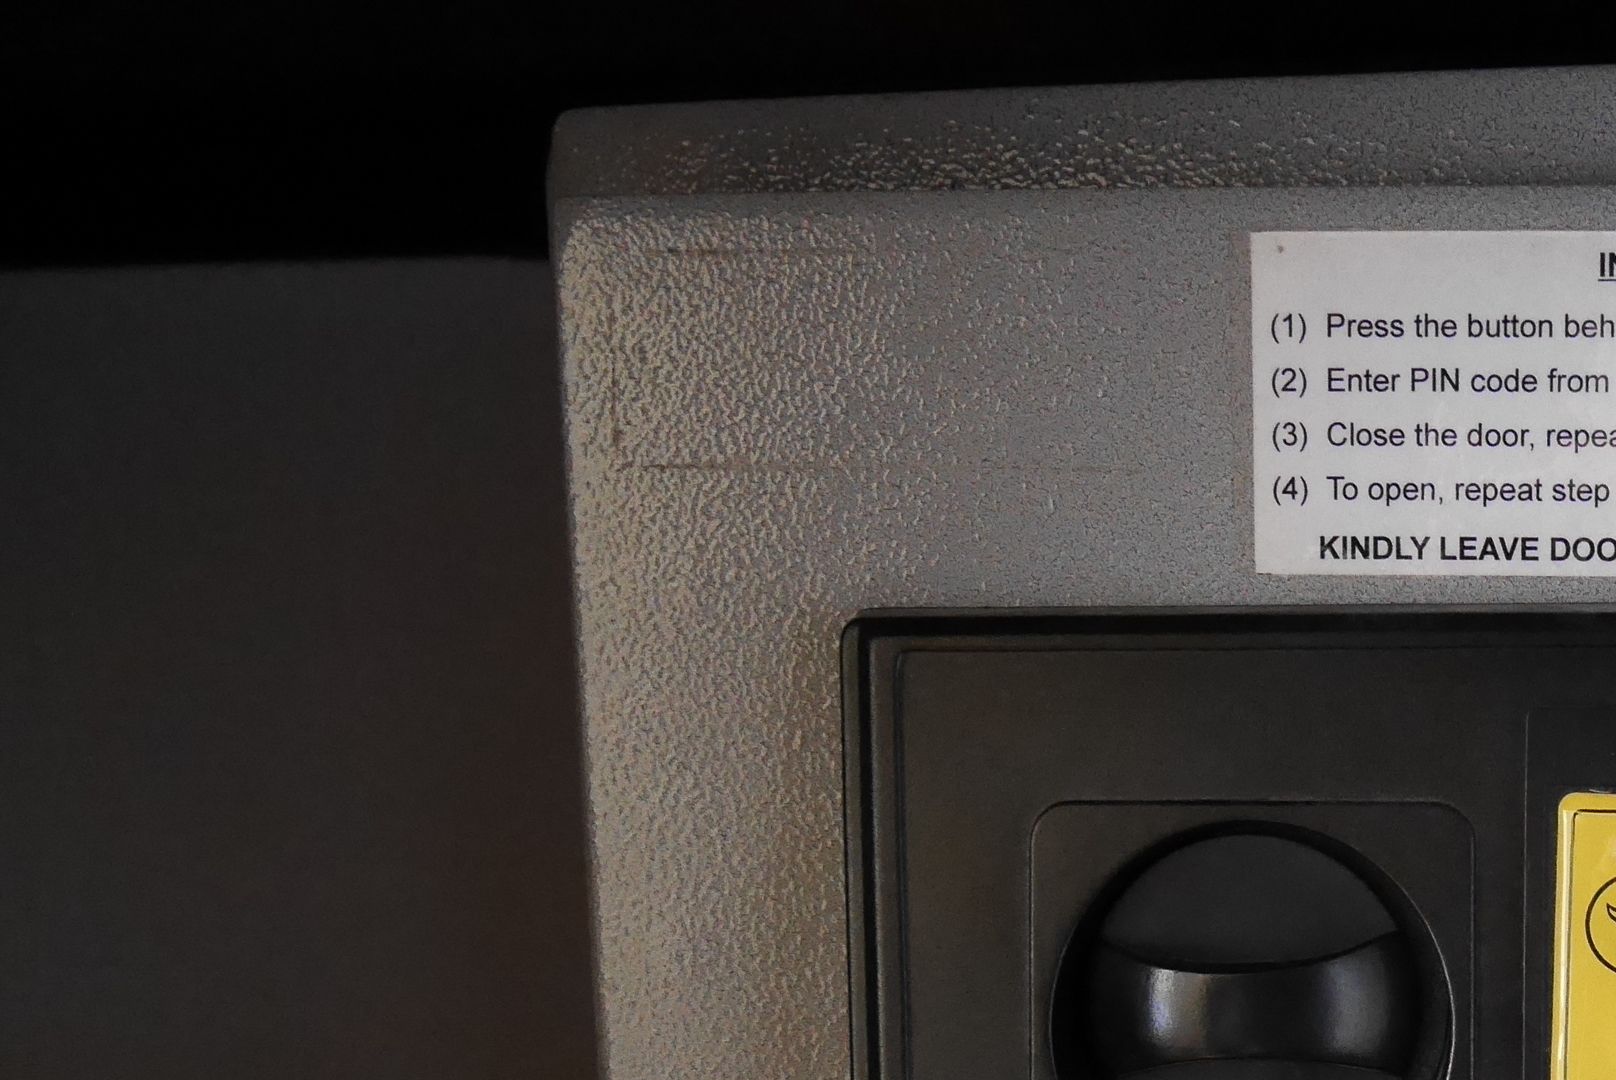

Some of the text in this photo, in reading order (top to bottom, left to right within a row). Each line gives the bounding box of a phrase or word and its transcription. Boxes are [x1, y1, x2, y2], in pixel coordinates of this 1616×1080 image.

[1270, 312, 1307, 345] (1)
[1326, 312, 1405, 339] Press
[1413, 312, 1458, 339] the
[1467, 312, 1554, 339] button
[1271, 367, 1308, 399] (2)
[1327, 366, 1401, 393] Enter
[1410, 367, 1460, 393] PIN
[1470, 367, 1538, 394] code
[1546, 367, 1609, 394] from
[1271, 421, 1308, 453] (3)
[1326, 421, 1406, 447] Close
[1413, 421, 1458, 448] the
[1466, 422, 1535, 452] door,
[1272, 475, 1309, 507] (4)
[1325, 475, 1359, 501] To
[1367, 481, 1444, 507] open,
[1454, 477, 1544, 508] repeat
[1551, 478, 1610, 509] step
[1319, 535, 1431, 561] KINDLY
[1439, 535, 1540, 562] LEAVE
